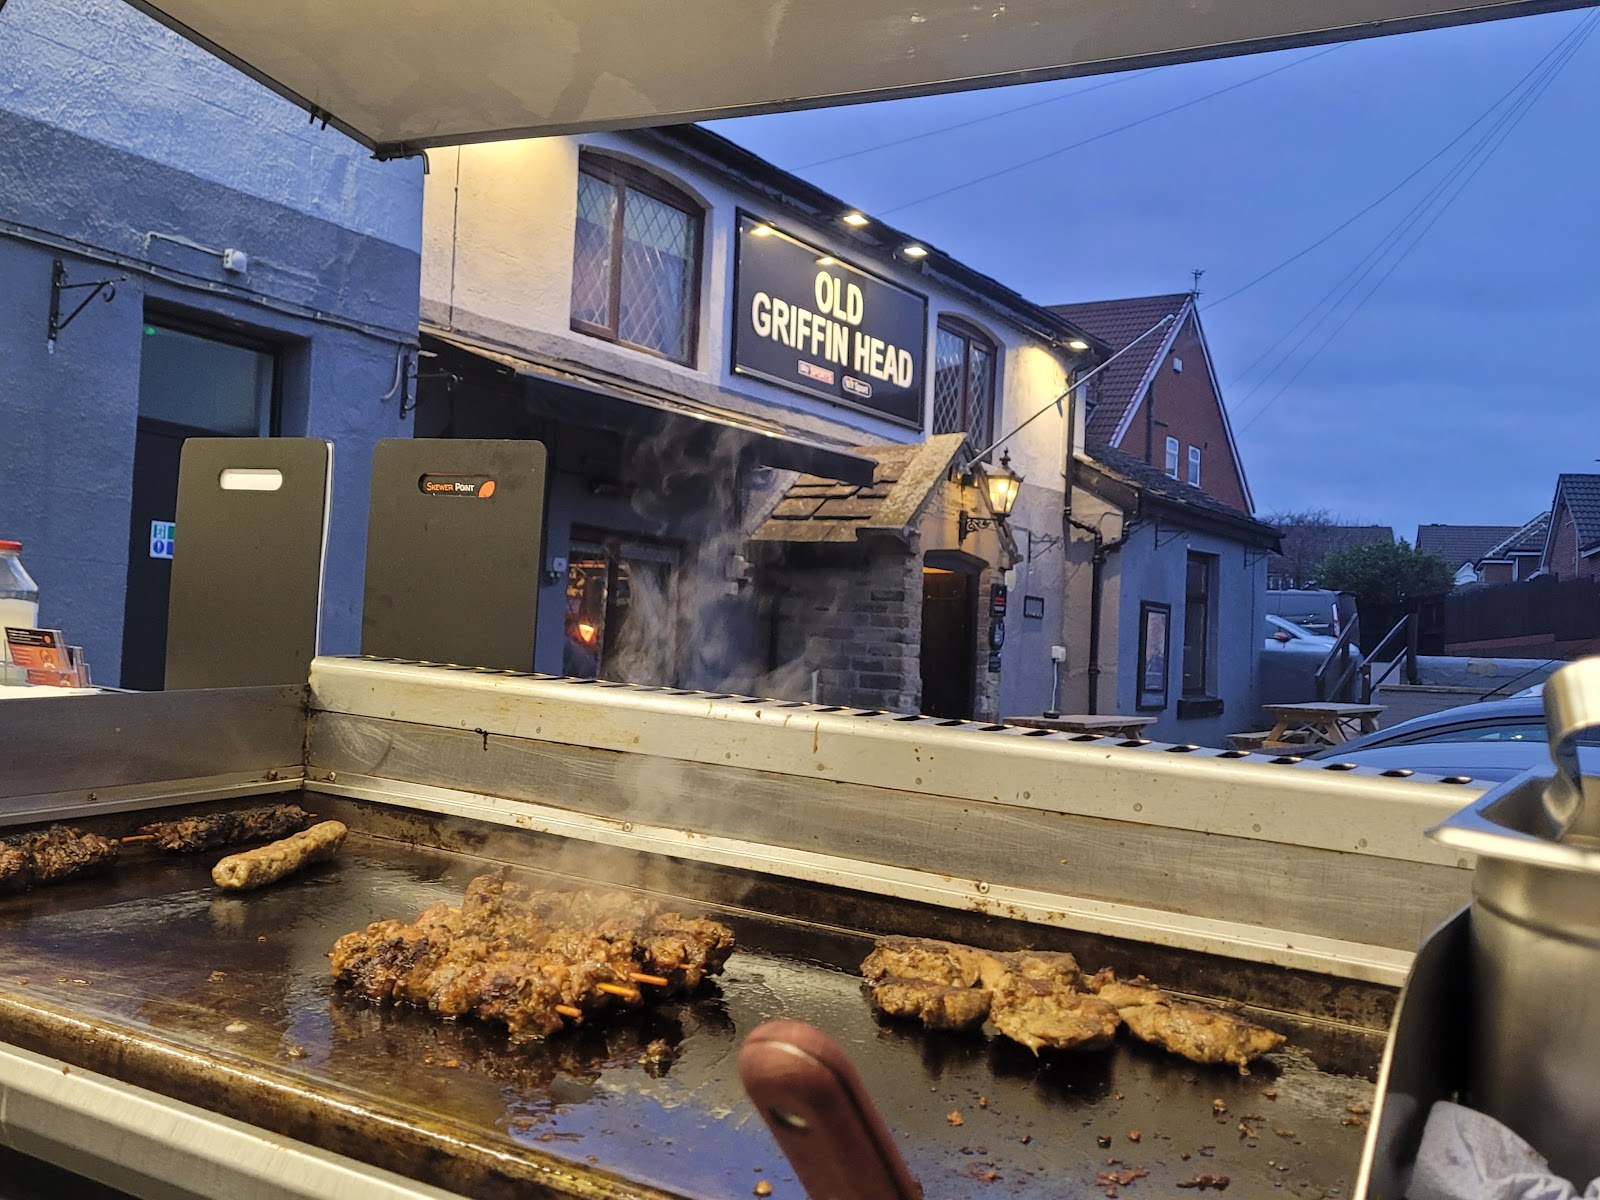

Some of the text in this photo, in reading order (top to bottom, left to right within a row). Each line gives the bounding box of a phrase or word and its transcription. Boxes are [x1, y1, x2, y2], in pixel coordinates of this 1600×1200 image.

[815, 271, 863, 325] OLD
[752, 291, 914, 389] GRIFFIN HEAD
[426, 482, 475, 491] SKEWER POINT
